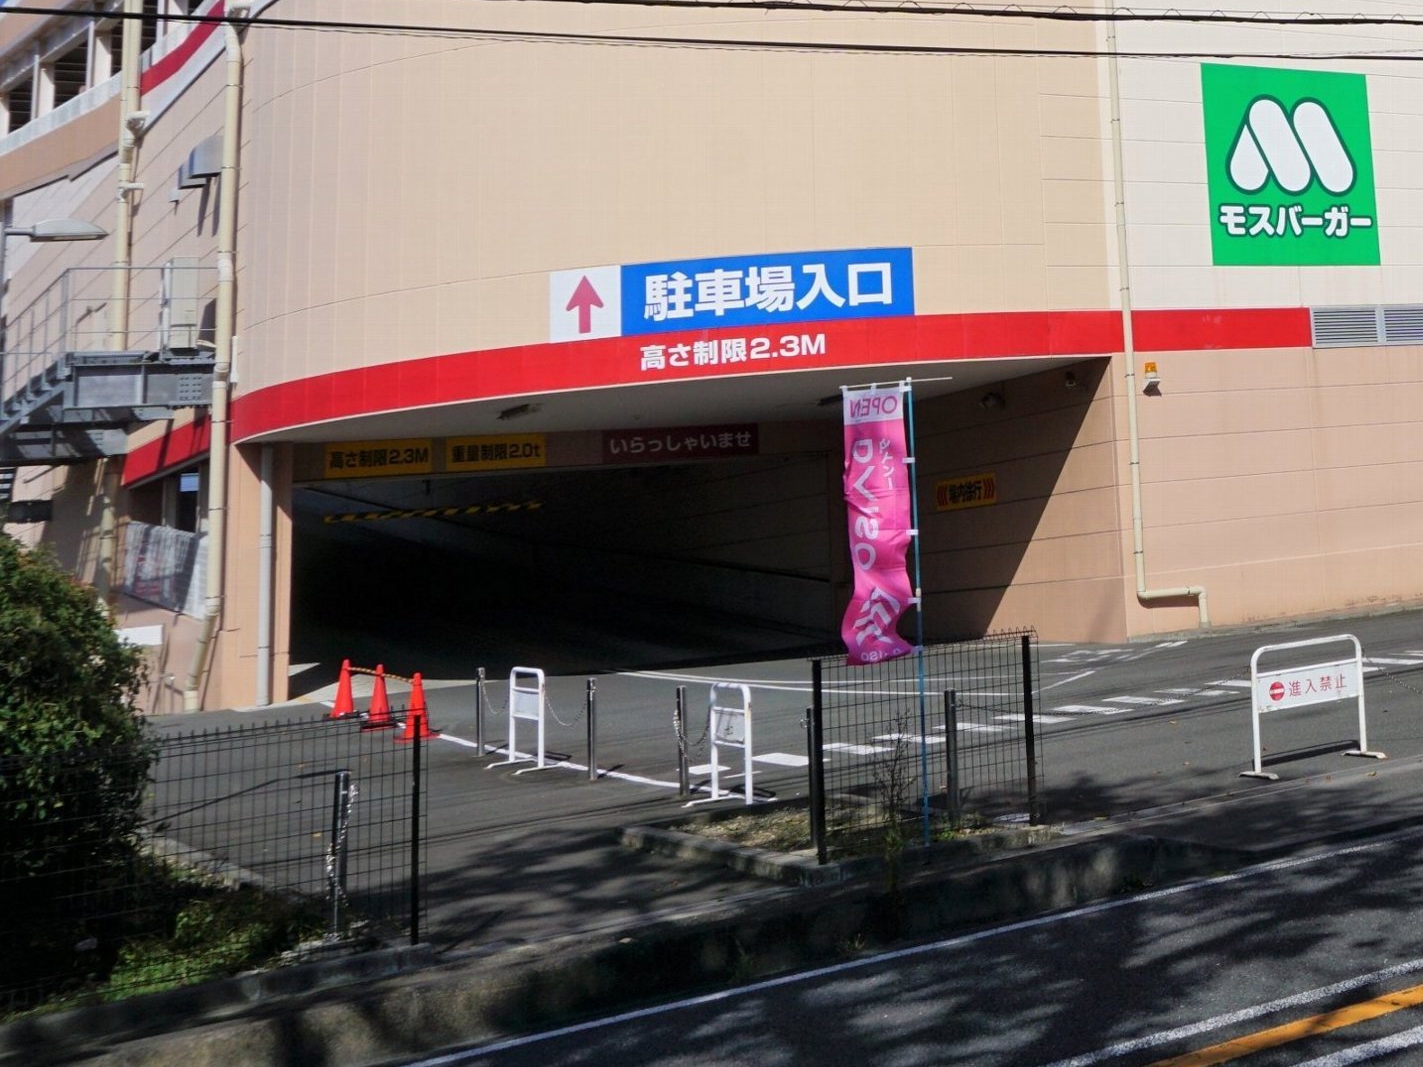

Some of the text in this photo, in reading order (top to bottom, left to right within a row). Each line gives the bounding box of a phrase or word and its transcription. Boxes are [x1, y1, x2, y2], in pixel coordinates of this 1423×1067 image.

[1218, 205, 1373, 238] モスバーガー
[643, 262, 893, 322] 駐車場入口
[639, 333, 827, 372] 高さ制限2.3M
[451, 441, 542, 464] 重量制限2.0t
[609, 430, 752, 455] いらっしゃいませ
[329, 447, 430, 470] 高さ制限2.3M
[1288, 673, 1348, 698] 進入禁止
